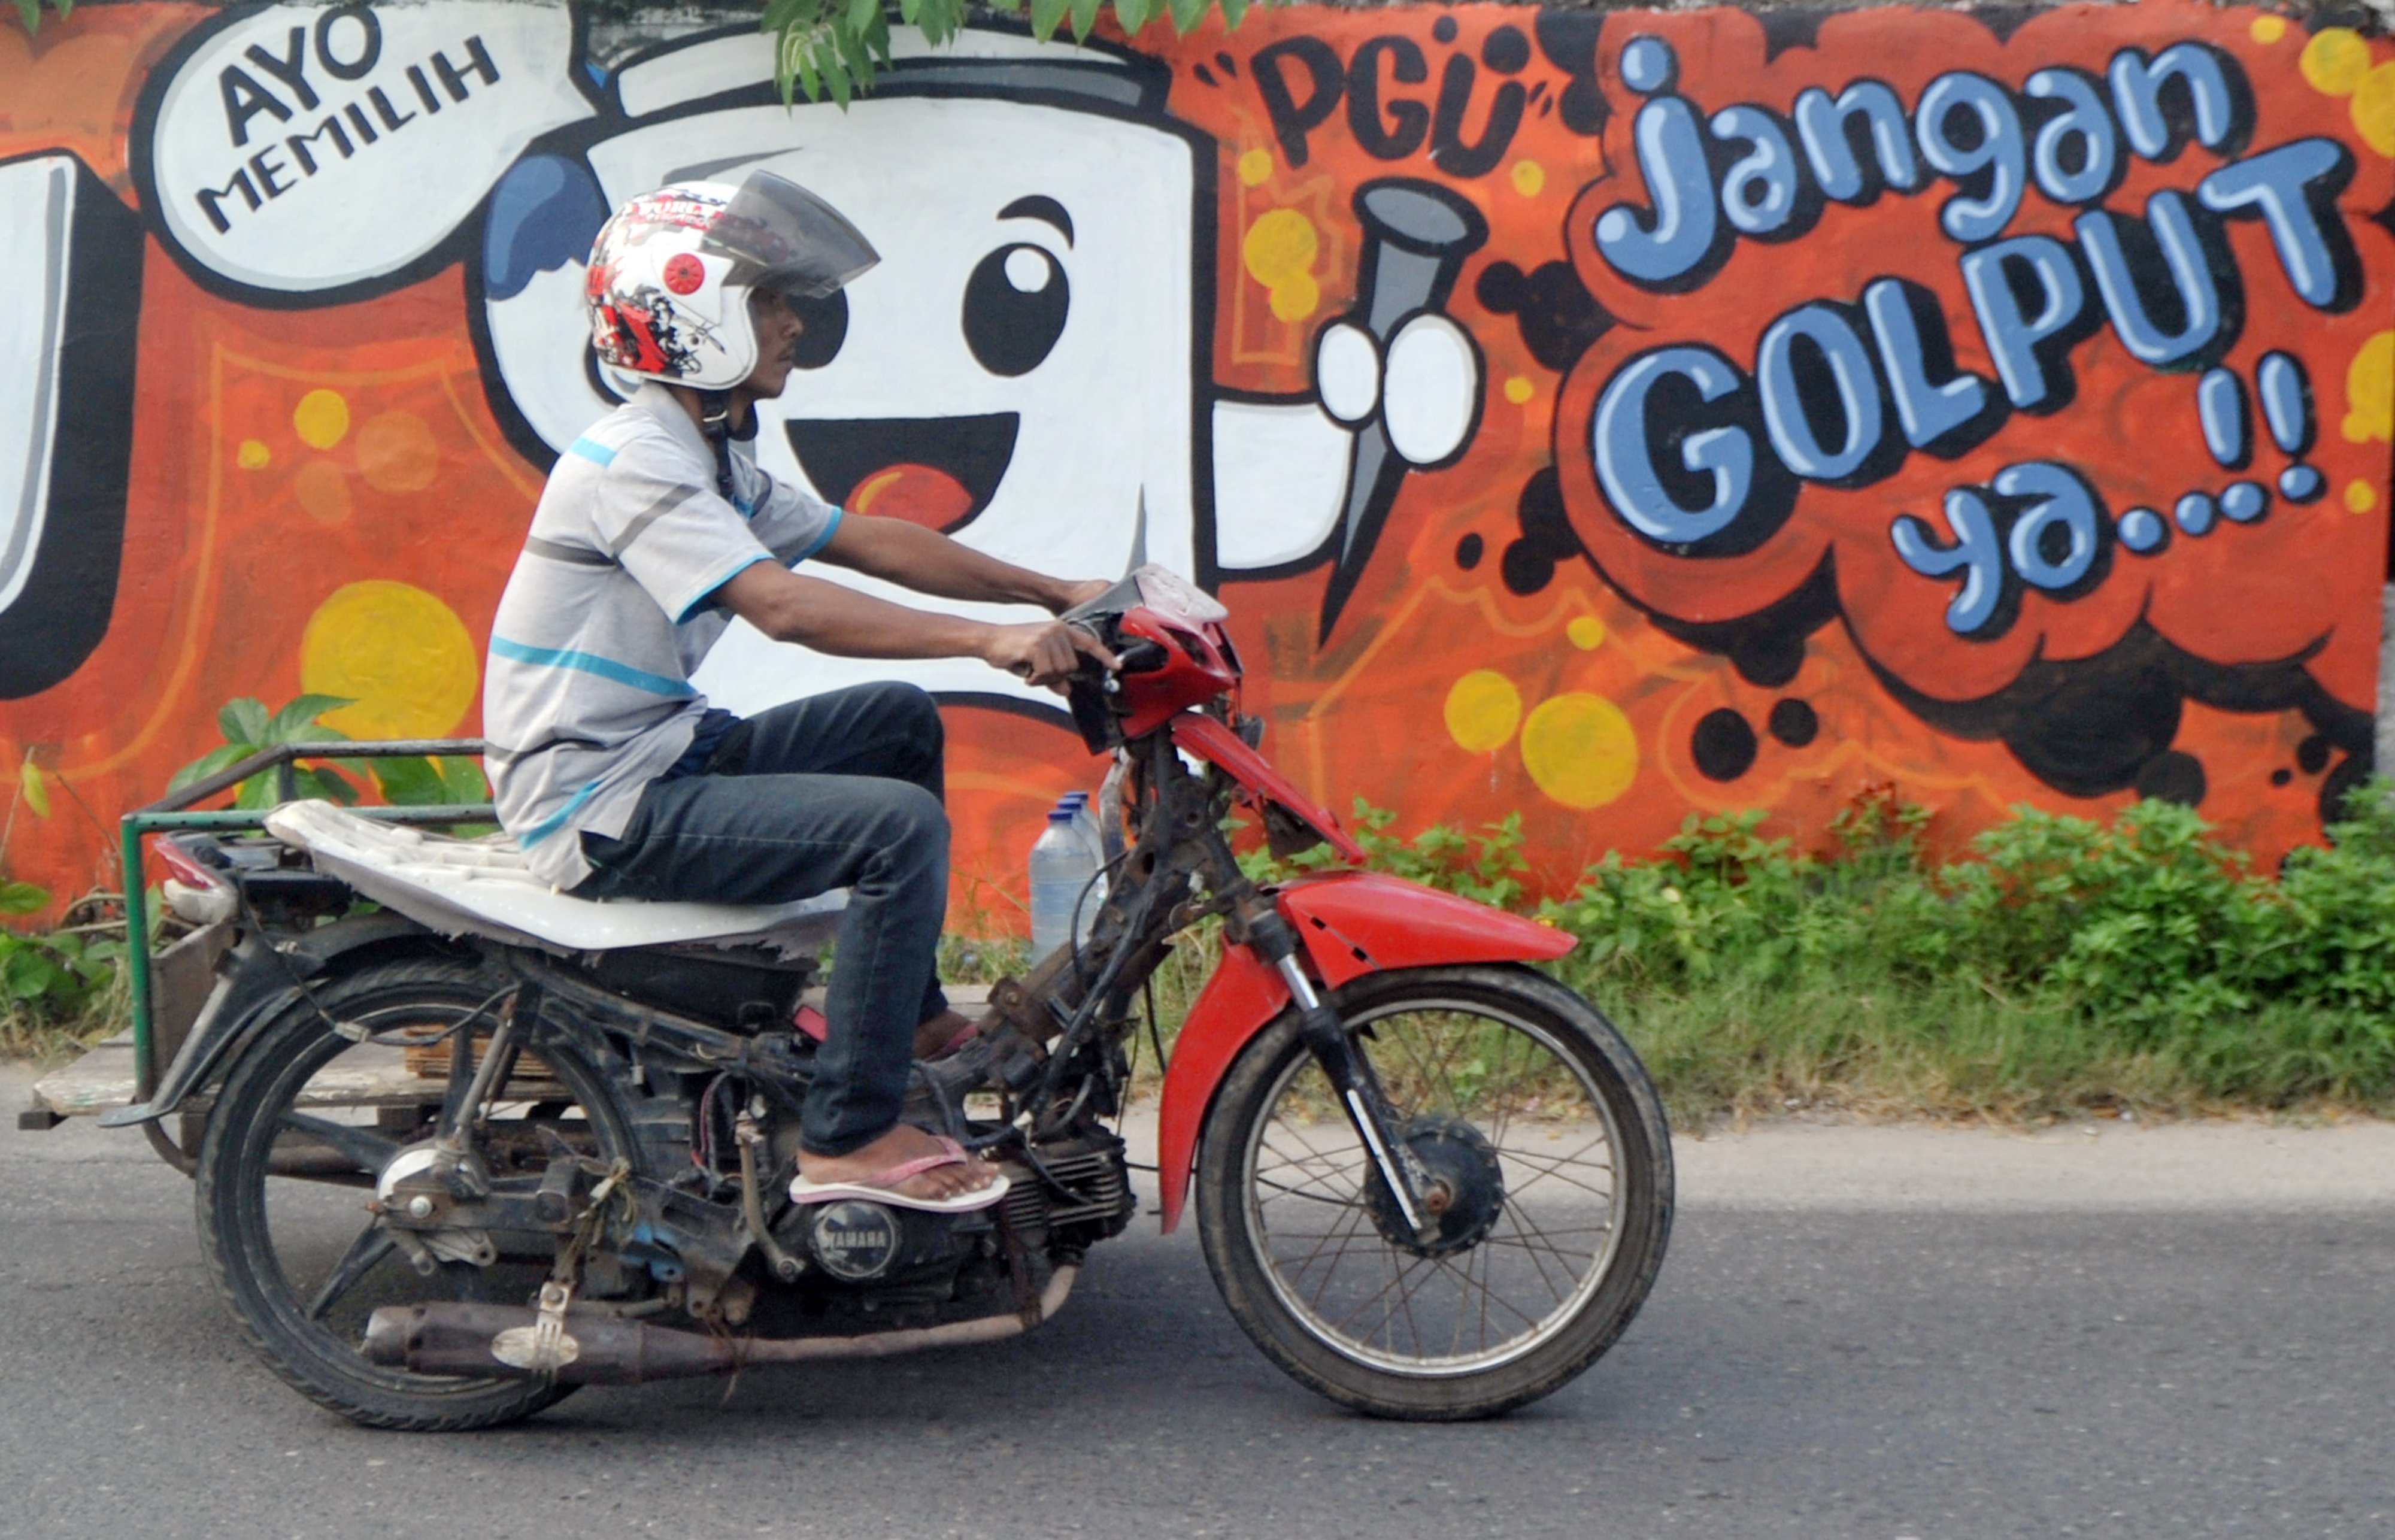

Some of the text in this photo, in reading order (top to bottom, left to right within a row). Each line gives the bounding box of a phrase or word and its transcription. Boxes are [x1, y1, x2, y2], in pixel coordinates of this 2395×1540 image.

[195, 34, 501, 236] MEMILIH
[219, 5, 383, 148] AYO
[1593, 35, 2236, 284] jangan
[1591, 137, 2344, 545] GOLPUT
